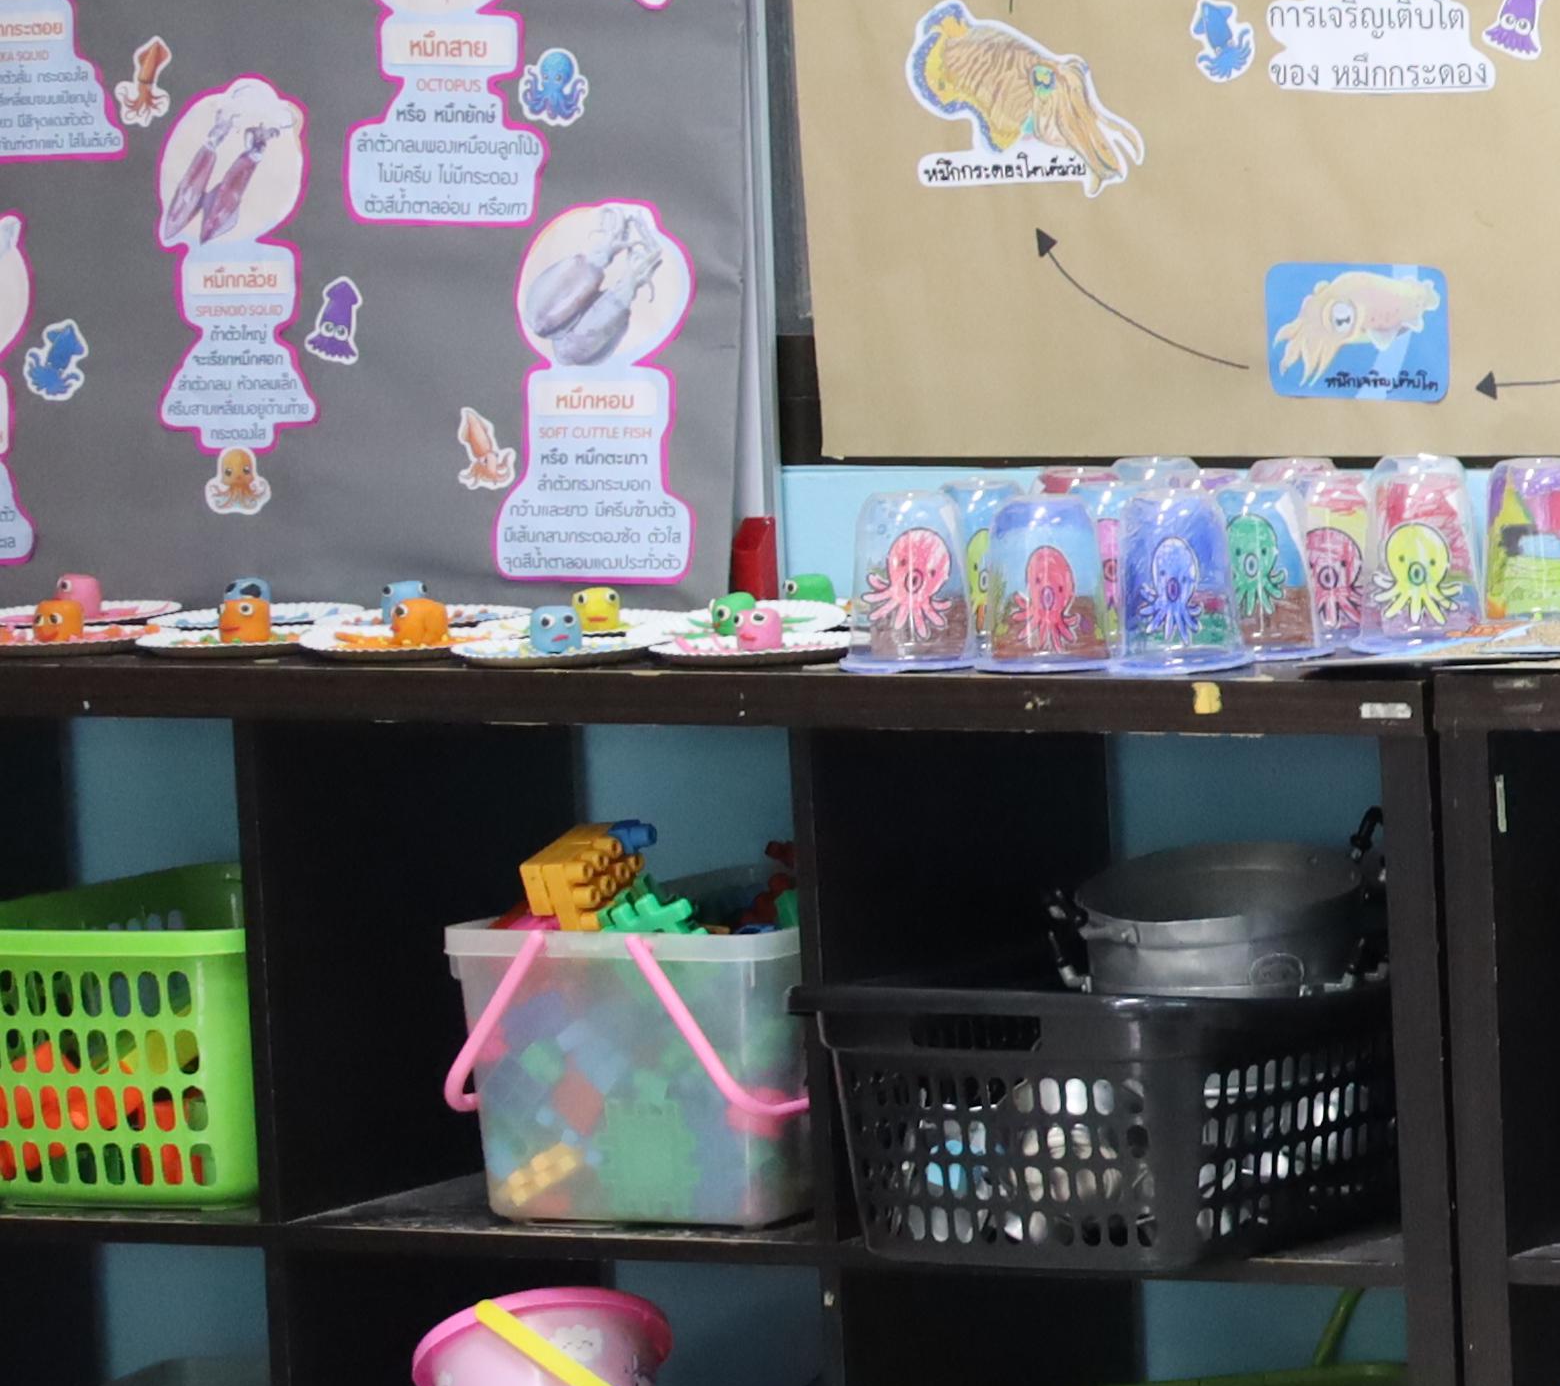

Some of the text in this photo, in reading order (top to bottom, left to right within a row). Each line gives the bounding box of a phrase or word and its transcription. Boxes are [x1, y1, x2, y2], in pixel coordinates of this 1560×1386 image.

[409, 30, 488, 58] หมึกสาย
[1270, 52, 1489, 87] ของ หมึกกระดอง
[416, 78, 482, 93] OCTOPUS
[396, 102, 426, 123] หรือ
[202, 266, 278, 289] หมึกกล้วย
[555, 385, 635, 410] หมึกหอม
[538, 426, 653, 439] SOFT CUTTLE FISH
[540, 446, 569, 466] หรือ
